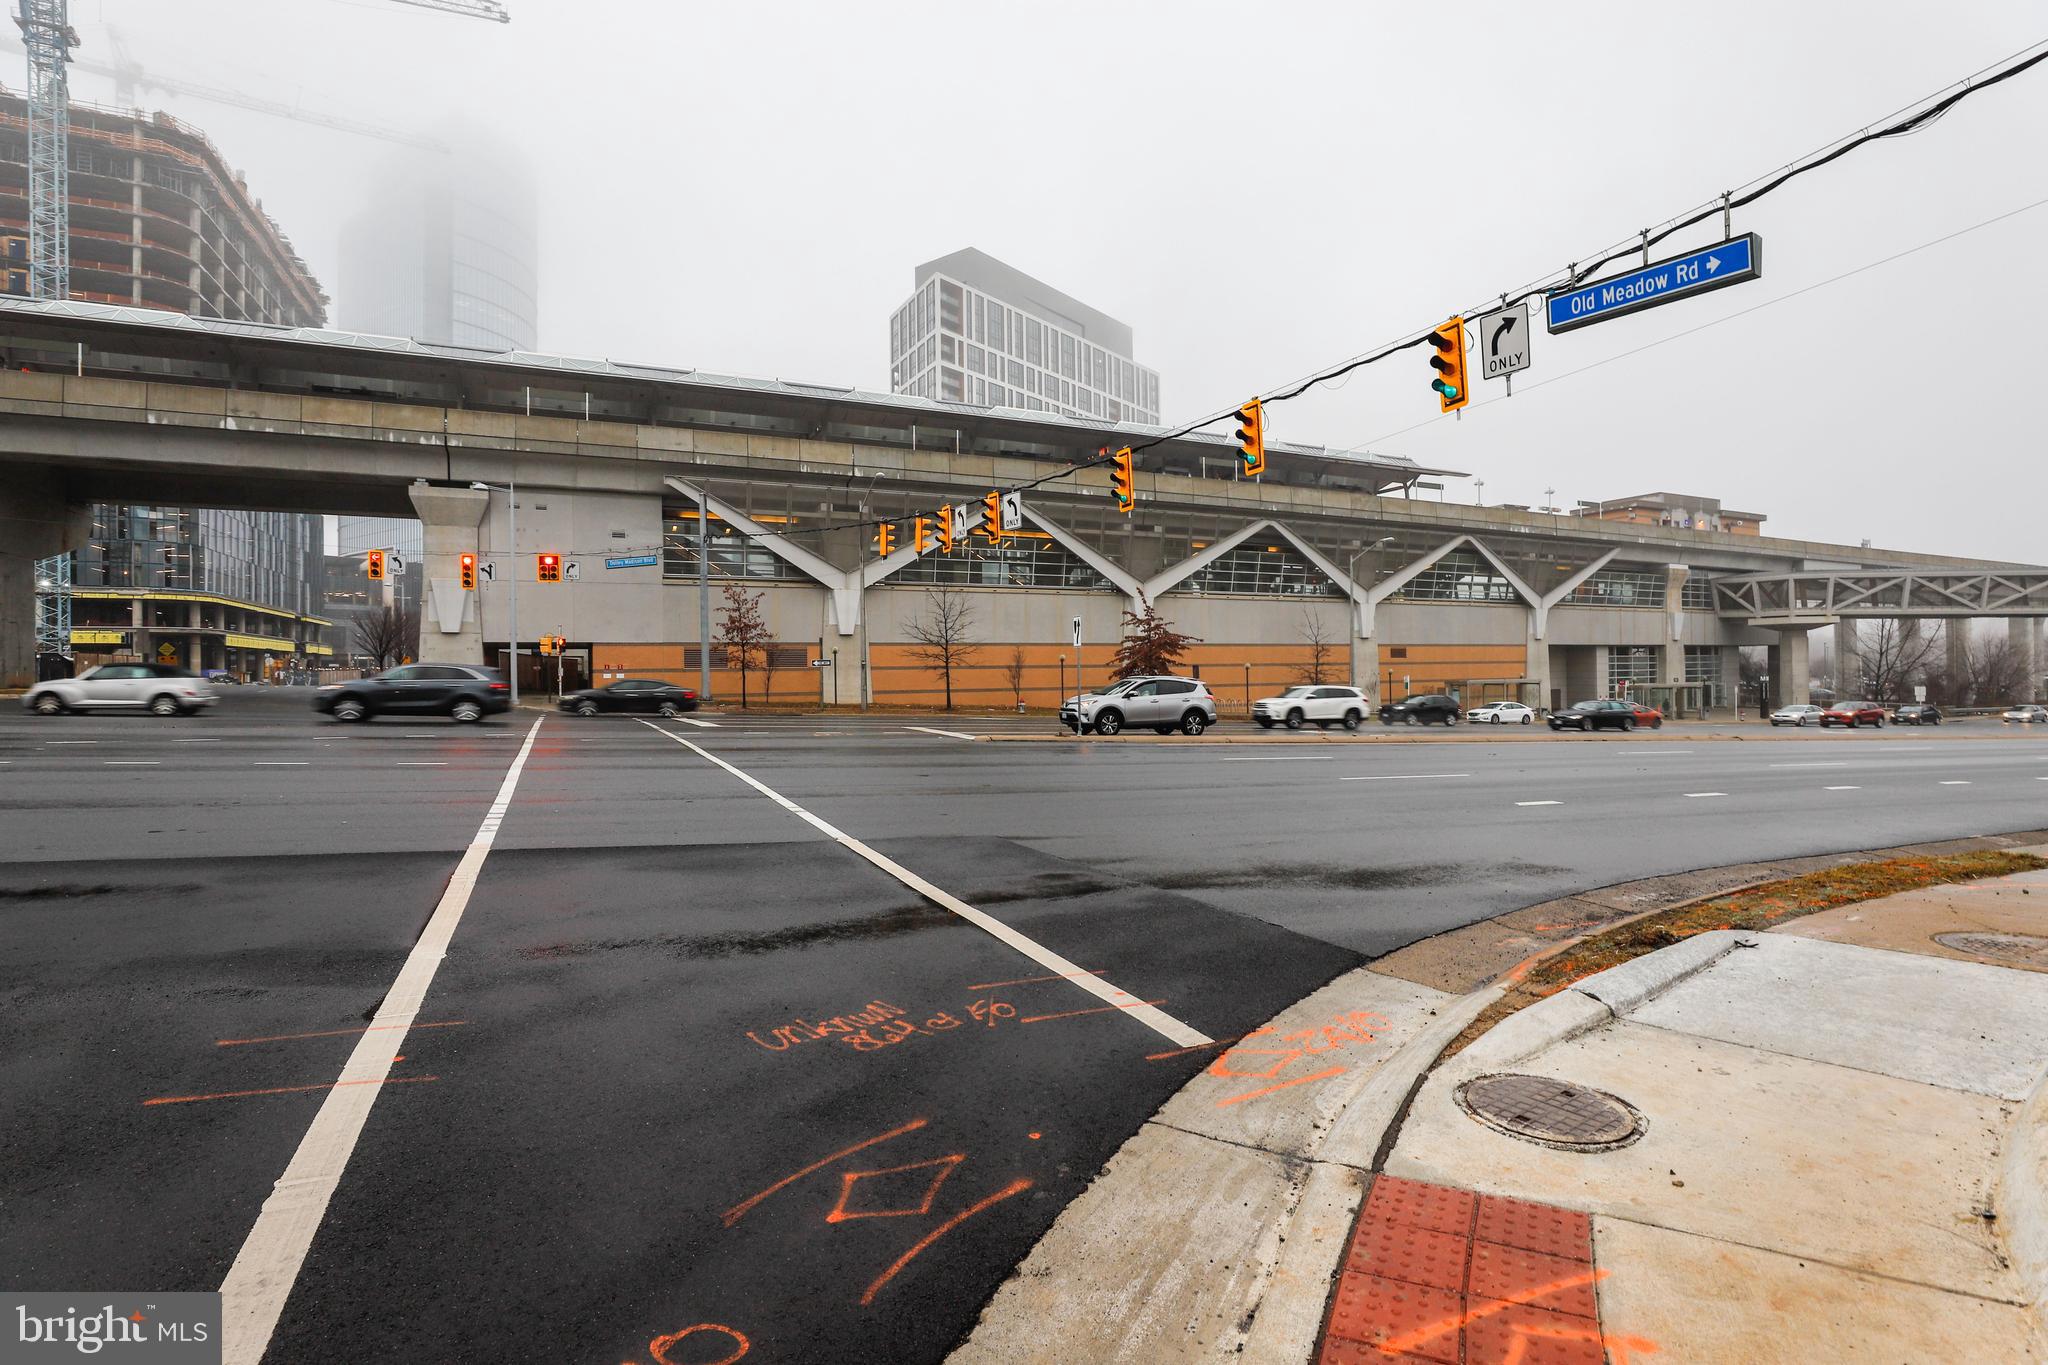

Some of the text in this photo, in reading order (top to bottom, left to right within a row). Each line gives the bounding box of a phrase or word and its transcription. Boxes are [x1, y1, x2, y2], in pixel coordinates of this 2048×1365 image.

[1571, 260, 1699, 315] Old Meadow Rd
[1489, 351, 1523, 373] ONLY
[1005, 517, 1019, 528] ONLY
